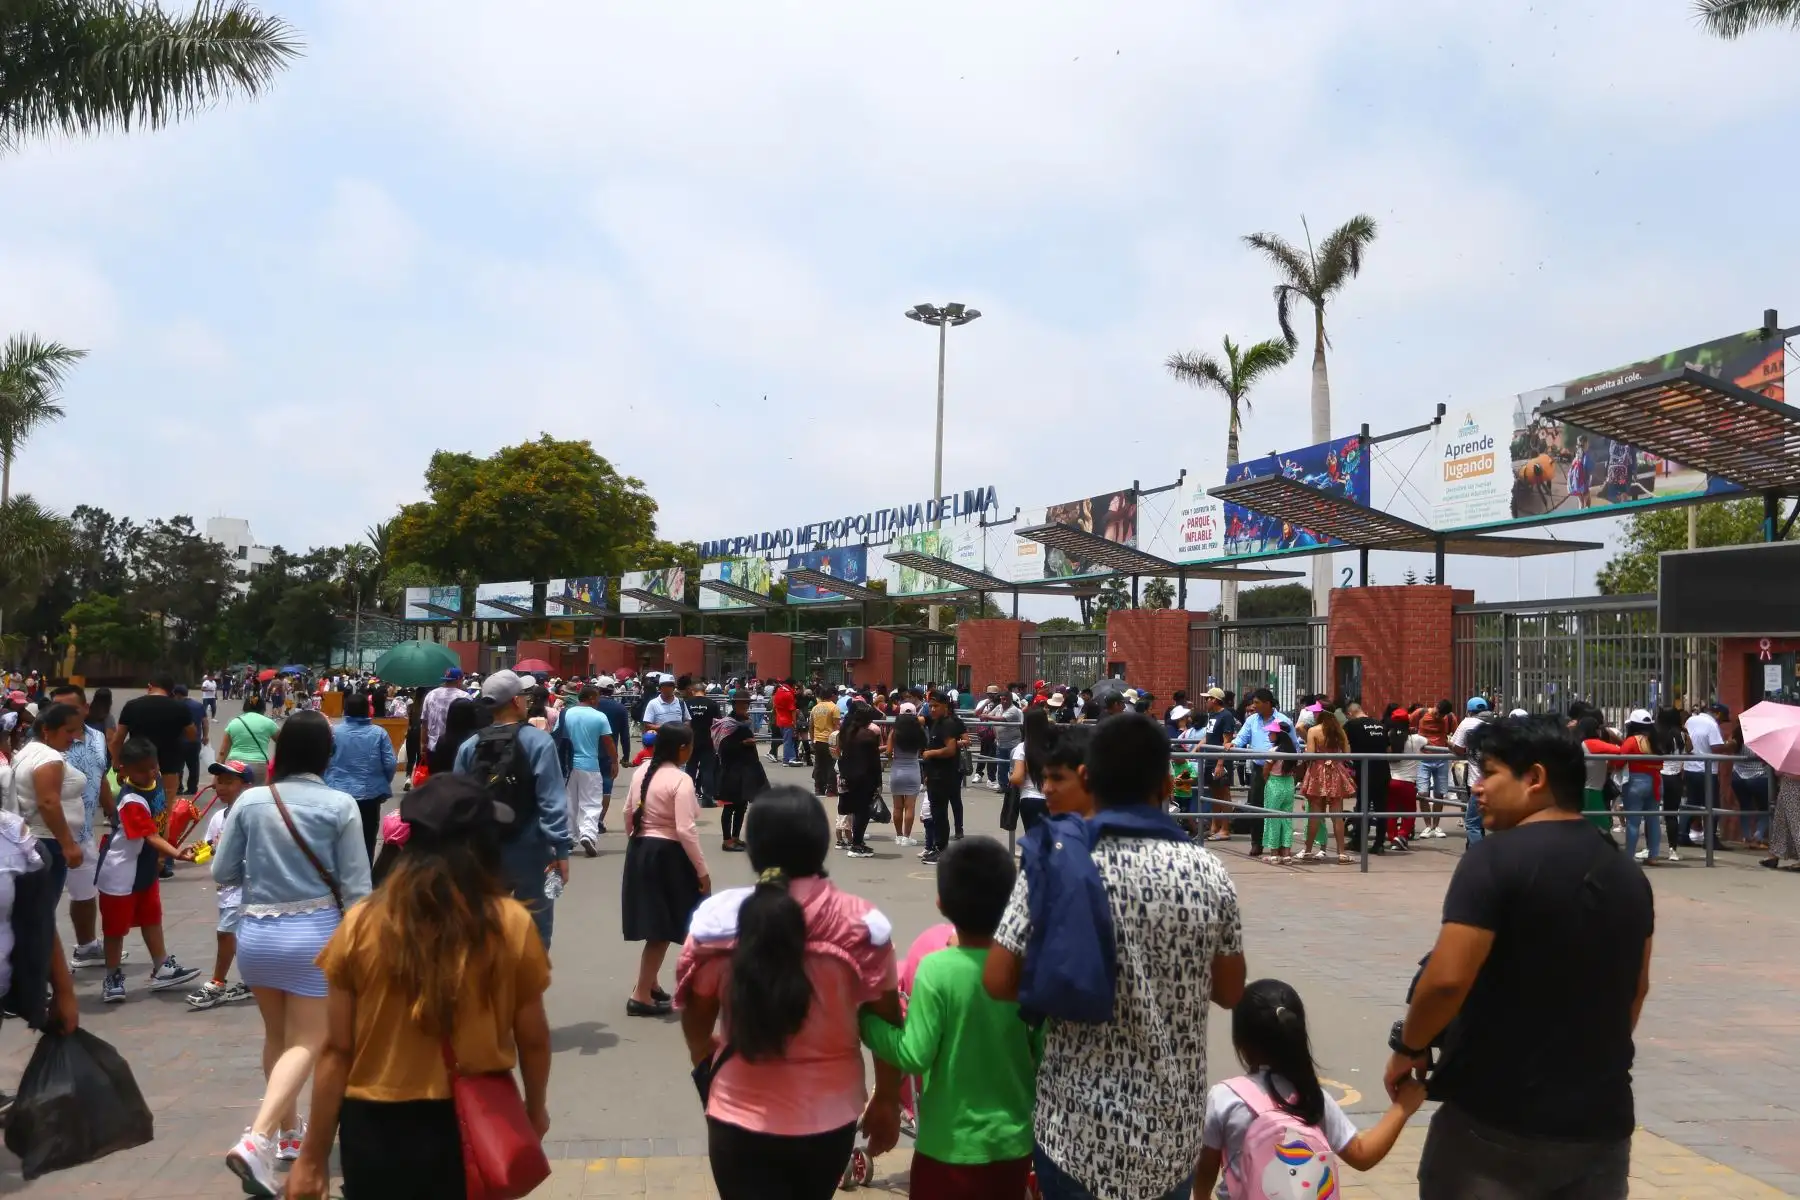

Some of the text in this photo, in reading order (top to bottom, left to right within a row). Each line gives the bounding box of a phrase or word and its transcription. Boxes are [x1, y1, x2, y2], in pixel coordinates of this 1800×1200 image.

[1593, 379, 1616, 392] vuelta
[1616, 375, 1624, 386] al
[1444, 434, 1494, 460] Aprende
[1445, 456, 1493, 480] Jugando
[697, 485, 999, 559] MUNICIPALIDAD METROPOLITANA DE LIMA
[1187, 515, 1210, 529] PARQUE
[1185, 529, 1212, 543] INFLABLE
[1187, 544, 1201, 552] GRANDE
[1341, 567, 1353, 588] 2
